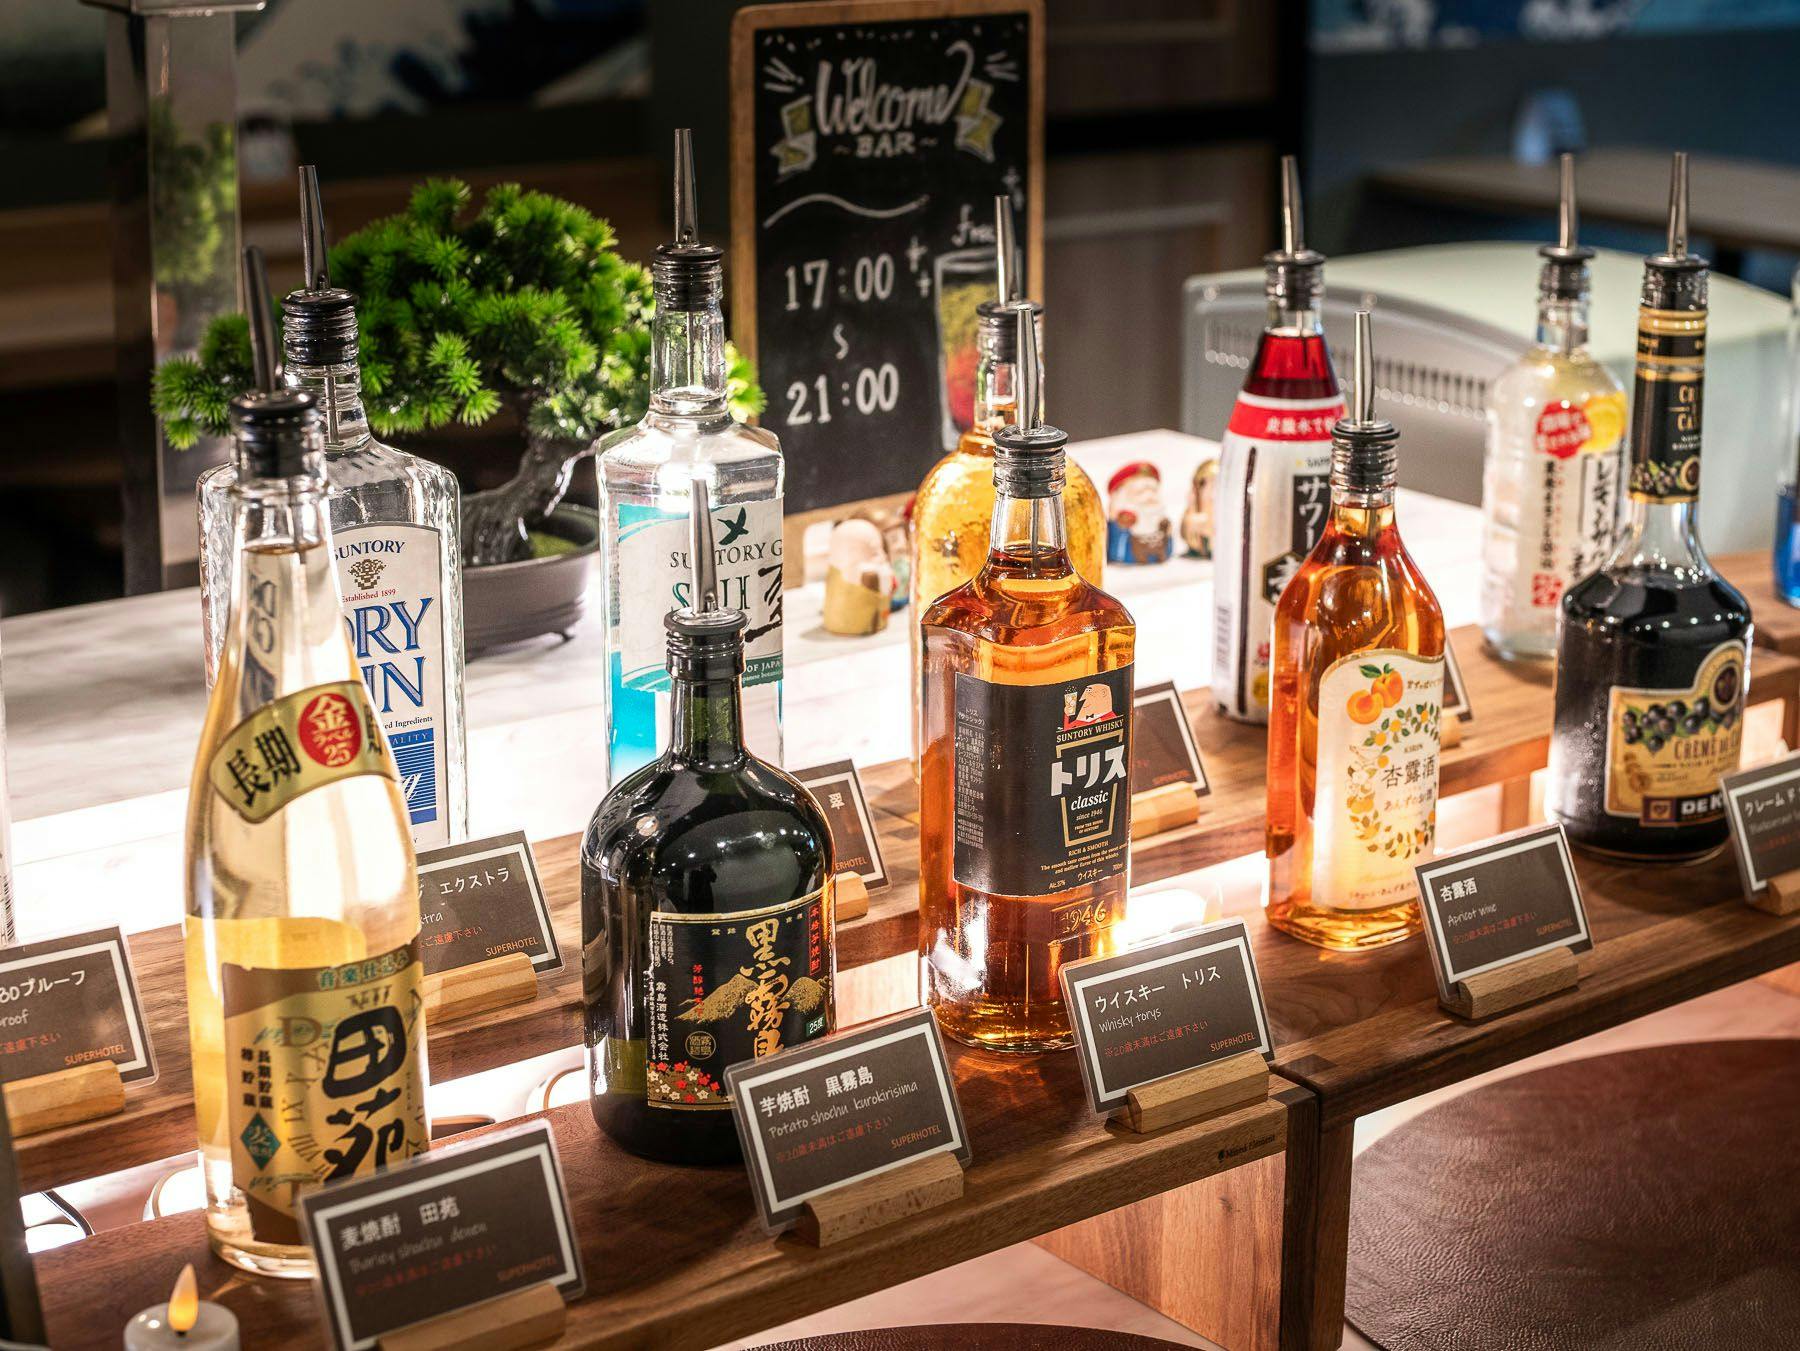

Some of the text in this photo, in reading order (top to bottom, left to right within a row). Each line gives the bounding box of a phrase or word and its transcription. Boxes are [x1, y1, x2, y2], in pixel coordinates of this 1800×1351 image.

[815, 40, 974, 135] Welcome
[857, 133, 916, 158] BAR
[784, 252, 895, 312] 17:00
[785, 362, 899, 426] 21:00
[670, 541, 766, 569] SUTORY
[360, 656, 426, 713] IN
[308, 695, 351, 732] 金
[396, 714, 433, 728] Ingredients
[1056, 718, 1125, 744] SUNTORY WHISKY
[226, 725, 302, 807] 長期
[323, 741, 352, 766] 25
[1050, 744, 1127, 797] トリス
[1381, 755, 1436, 789] 杏露酒
[1070, 790, 1110, 811] classic
[1681, 798, 1709, 815] DE
[1076, 811, 1090, 821] since
[1068, 847, 1083, 857] RICH
[1087, 840, 1110, 853] SMOOTH
[439, 867, 510, 895] エクストラ
[1077, 868, 1104, 882] ウイスキー
[1439, 876, 1478, 903] 杏露酒
[1447, 902, 1498, 928] Apricot wine
[485, 936, 539, 957] SUPERHOTEL
[1094, 965, 1221, 1014] ウイスキー トリス
[809, 1016, 824, 1035] 25度
[1135, 1006, 1163, 1025] torys
[63, 1043, 127, 1066] SUPERHOTEL
[1209, 1030, 1256, 1053] SUPERHOTEL
[759, 1065, 874, 1118] 芋焼酎 黒霧島
[768, 1080, 919, 1139] Potato shochu kurokirisima
[890, 1123, 942, 1150] SUPERHOTEL
[339, 1195, 461, 1251] 麦焼酎 田苑
